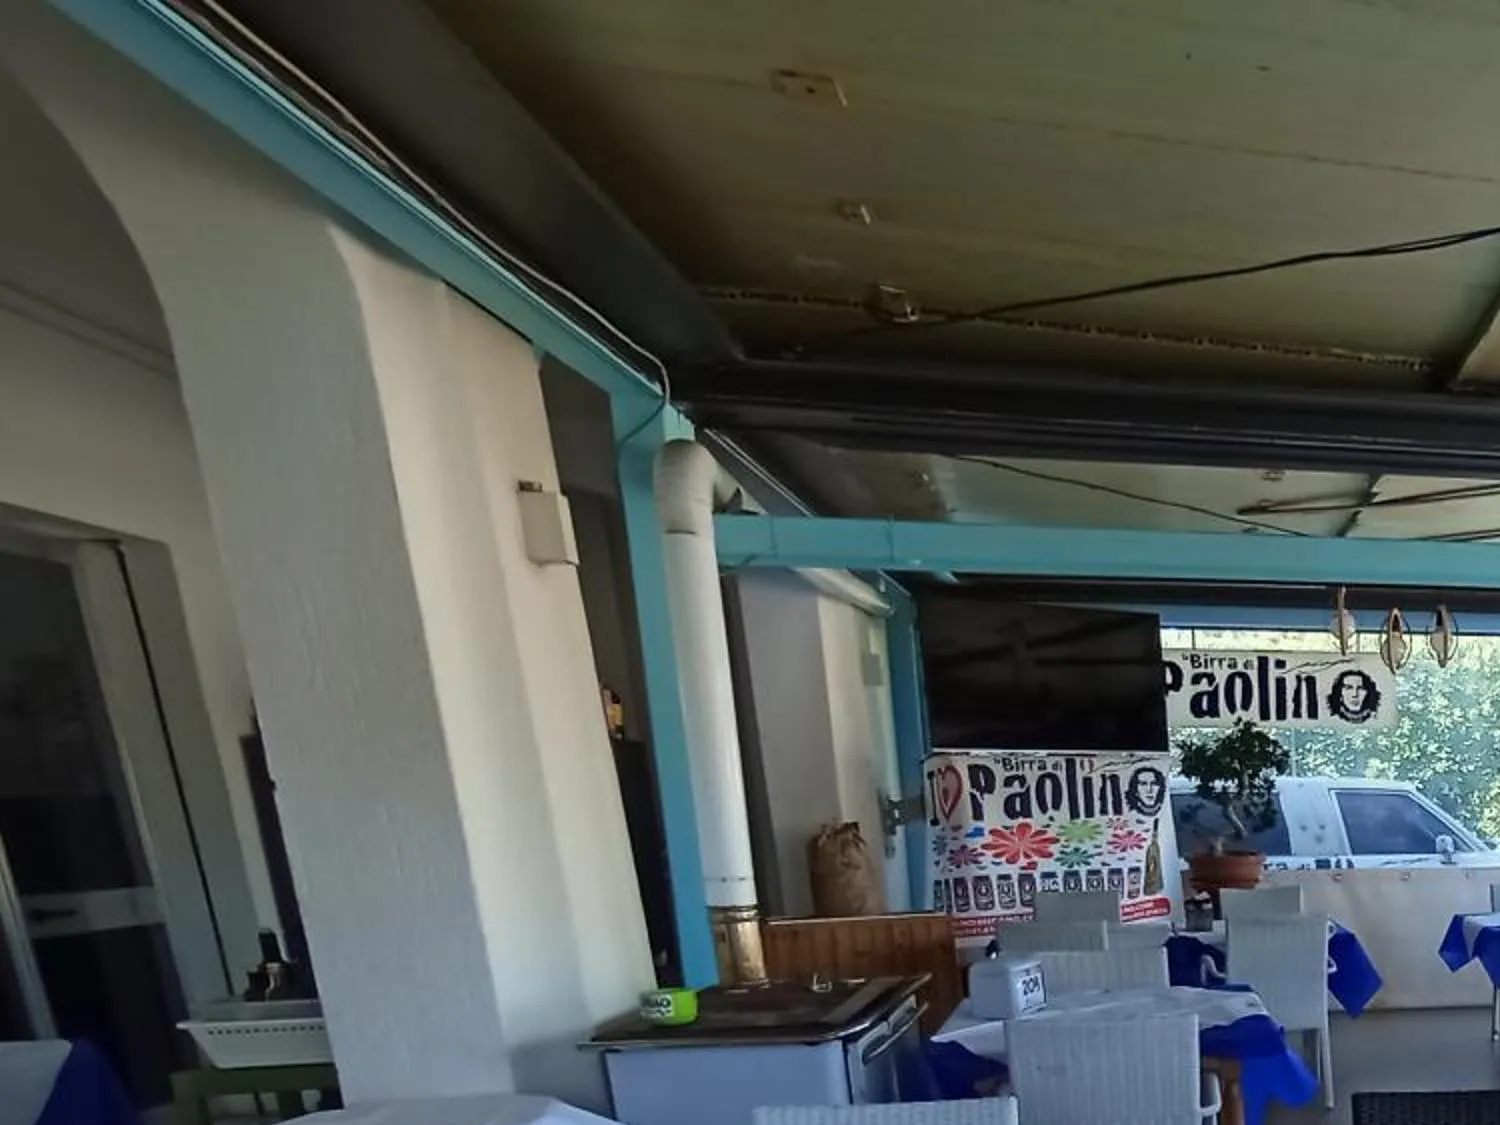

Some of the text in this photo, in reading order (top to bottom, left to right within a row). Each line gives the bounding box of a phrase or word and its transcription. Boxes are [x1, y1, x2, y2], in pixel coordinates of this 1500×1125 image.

[1189, 653, 1238, 670] Birra
[1003, 756, 1048, 772] Birra
[967, 757, 1124, 823] Paolin
